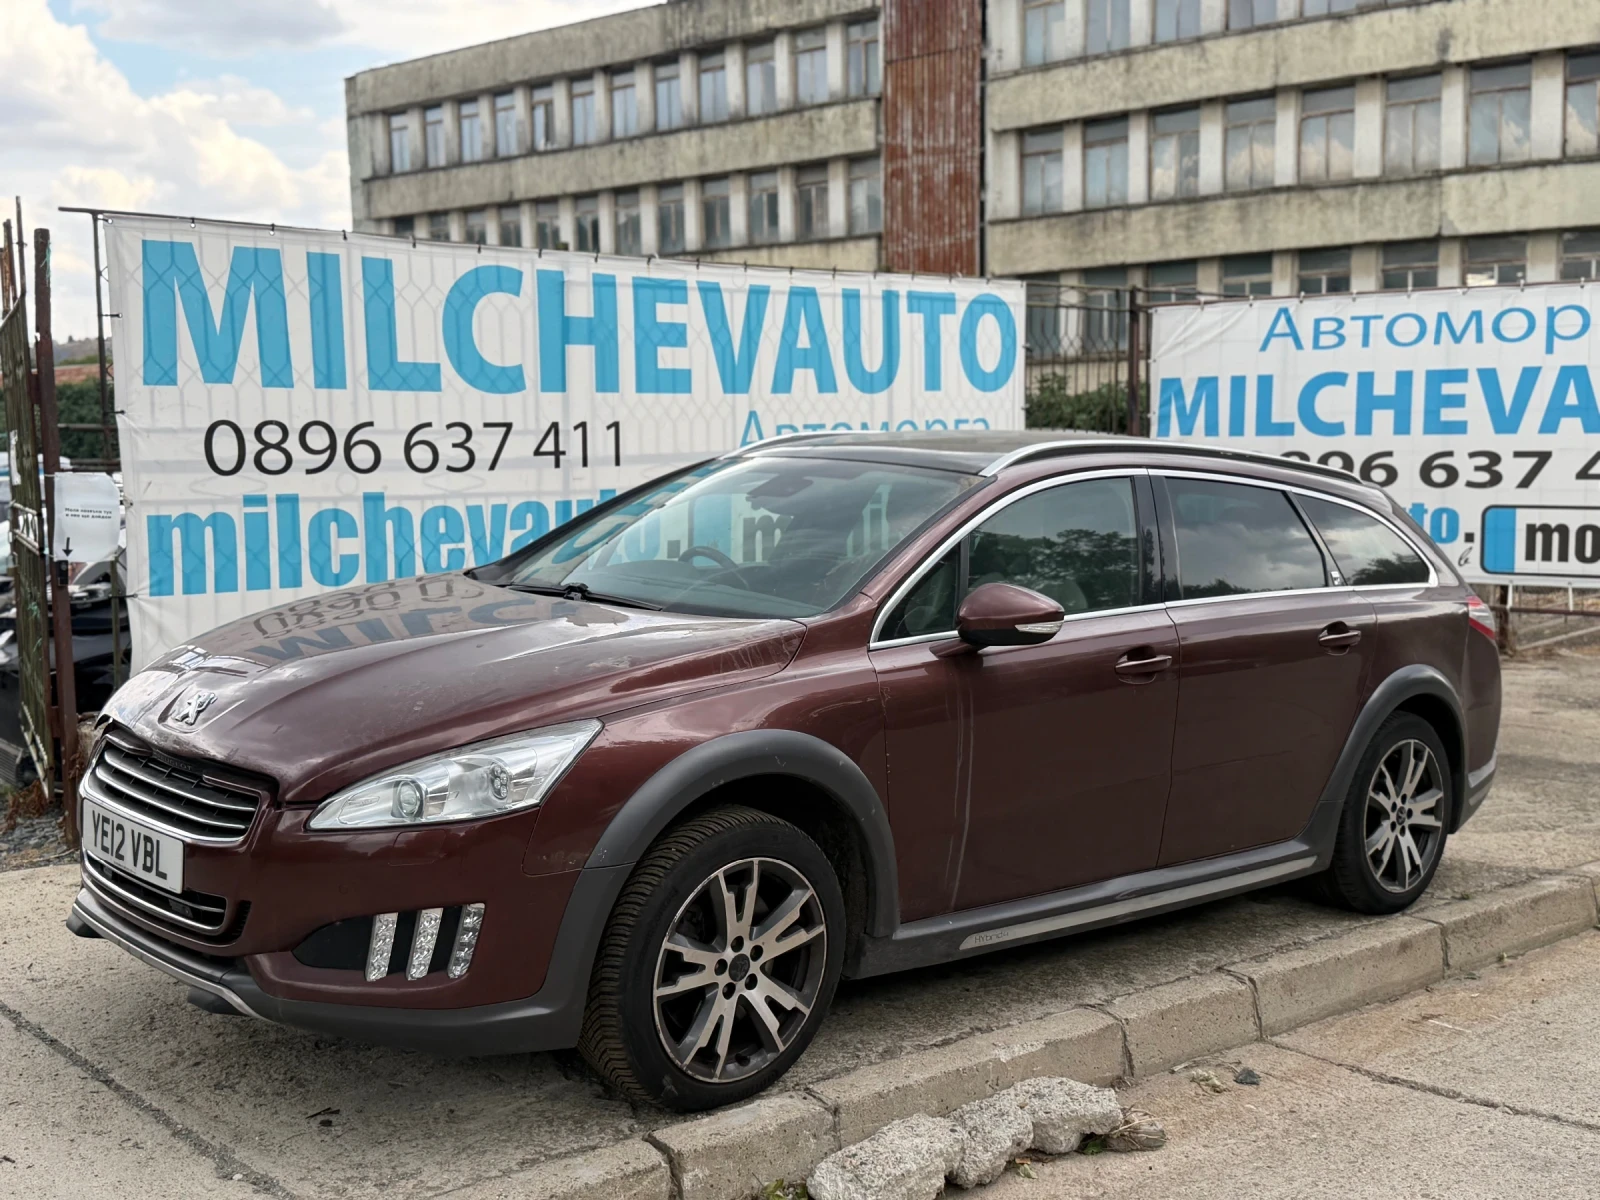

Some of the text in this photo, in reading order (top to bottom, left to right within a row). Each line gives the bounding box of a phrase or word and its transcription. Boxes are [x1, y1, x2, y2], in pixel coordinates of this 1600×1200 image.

[143, 241, 1016, 394] MILCHEVAUTO
[1157, 365, 1600, 437] MILCHEVA
[204, 420, 621, 476] 0896 637 411
[1419, 450, 1553, 488] 637
[92, 810, 168, 881] YE12 VBL
